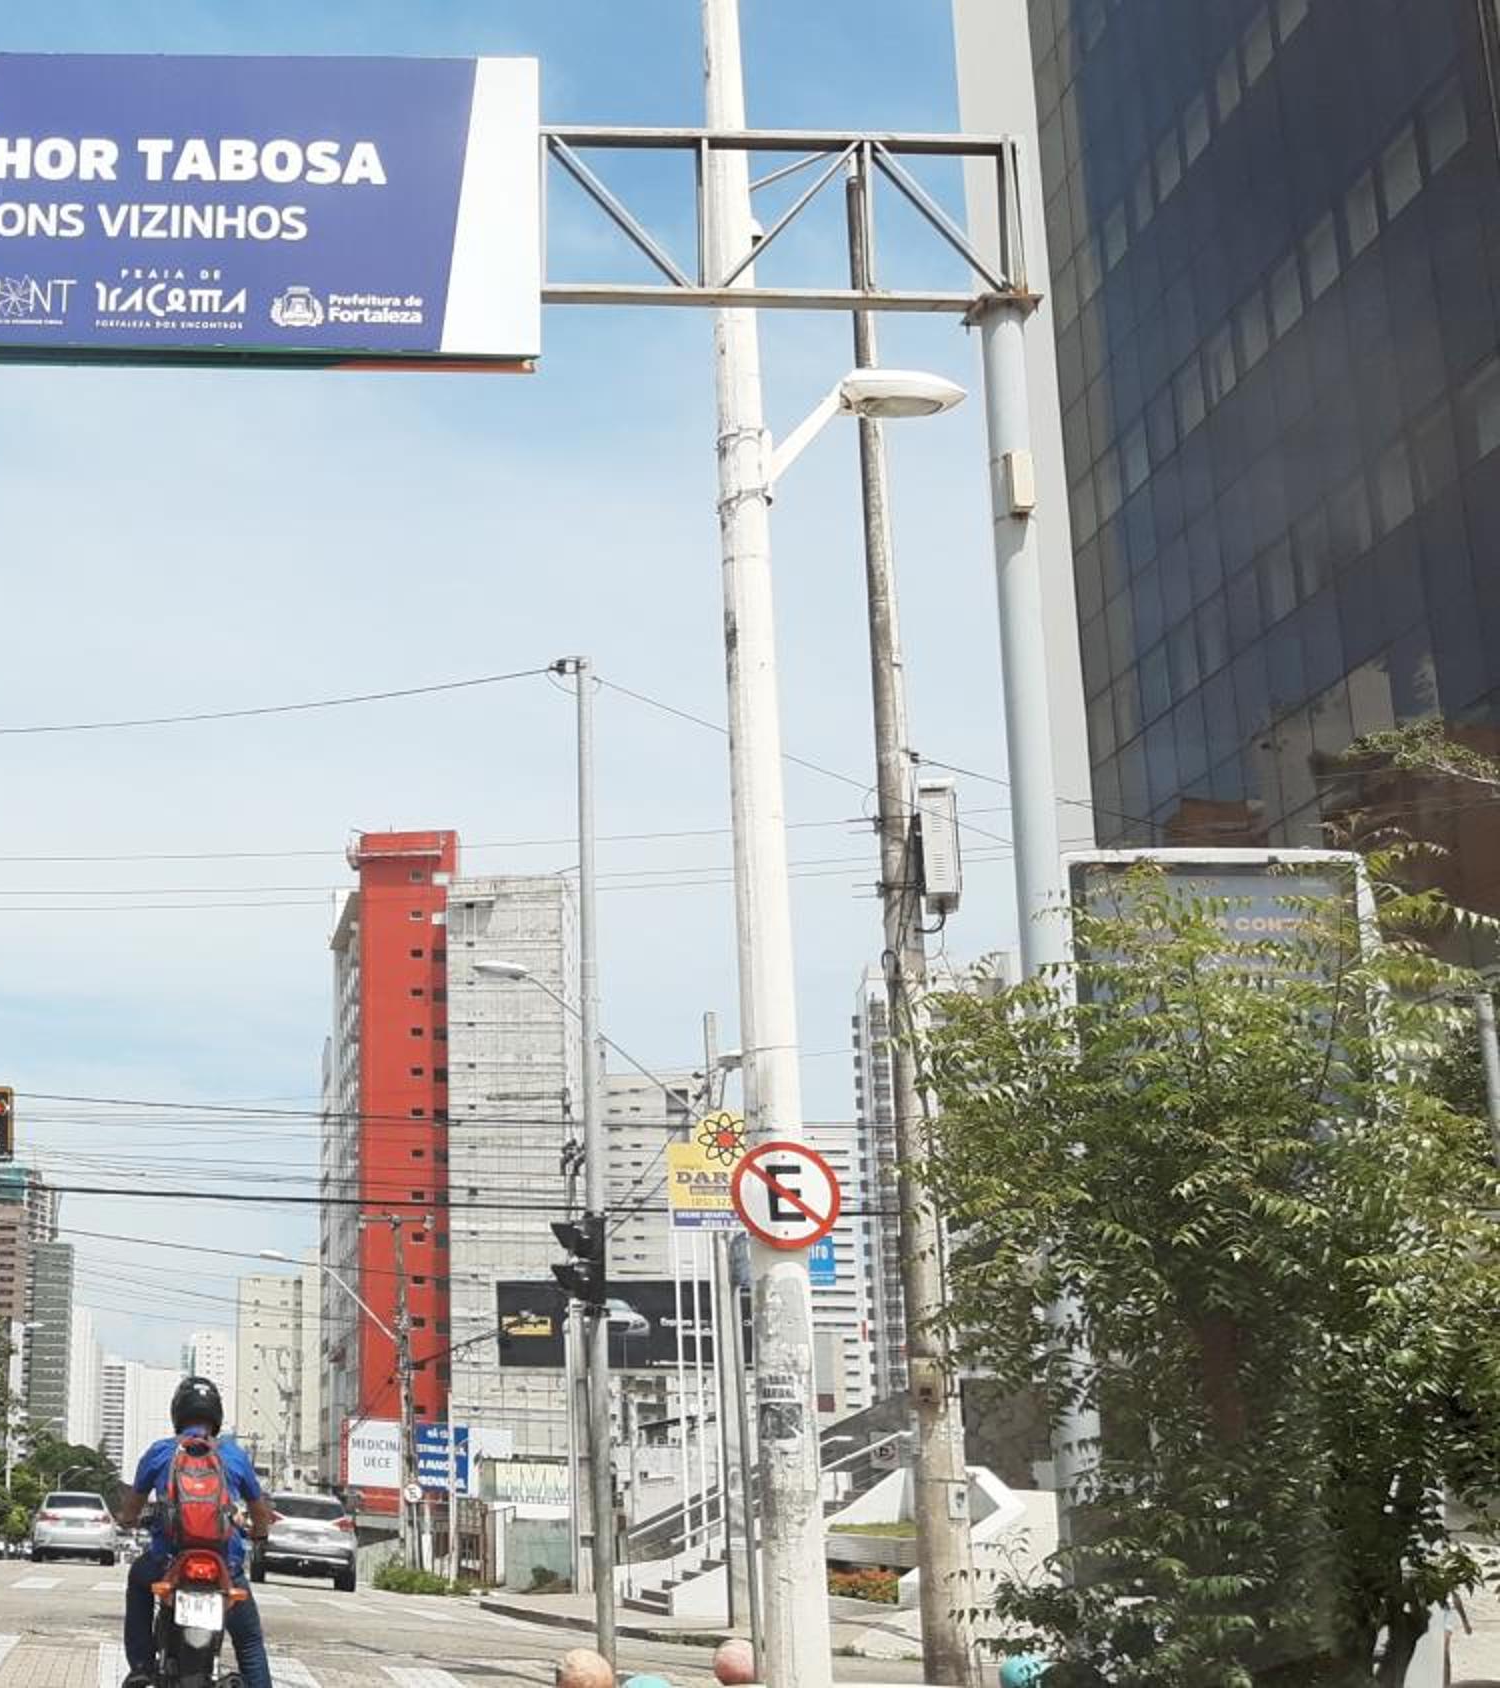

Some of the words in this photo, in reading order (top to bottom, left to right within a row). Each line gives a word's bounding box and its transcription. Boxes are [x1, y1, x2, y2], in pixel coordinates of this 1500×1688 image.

[137, 138, 387, 184] TABOSA
[98, 204, 308, 240] VIZINHOS
[121, 268, 184, 279] PRAIA
[200, 269, 221, 280] DE
[329, 294, 401, 308] Prefeitura
[404, 297, 423, 308] de
[328, 307, 423, 323] Fortaleza
